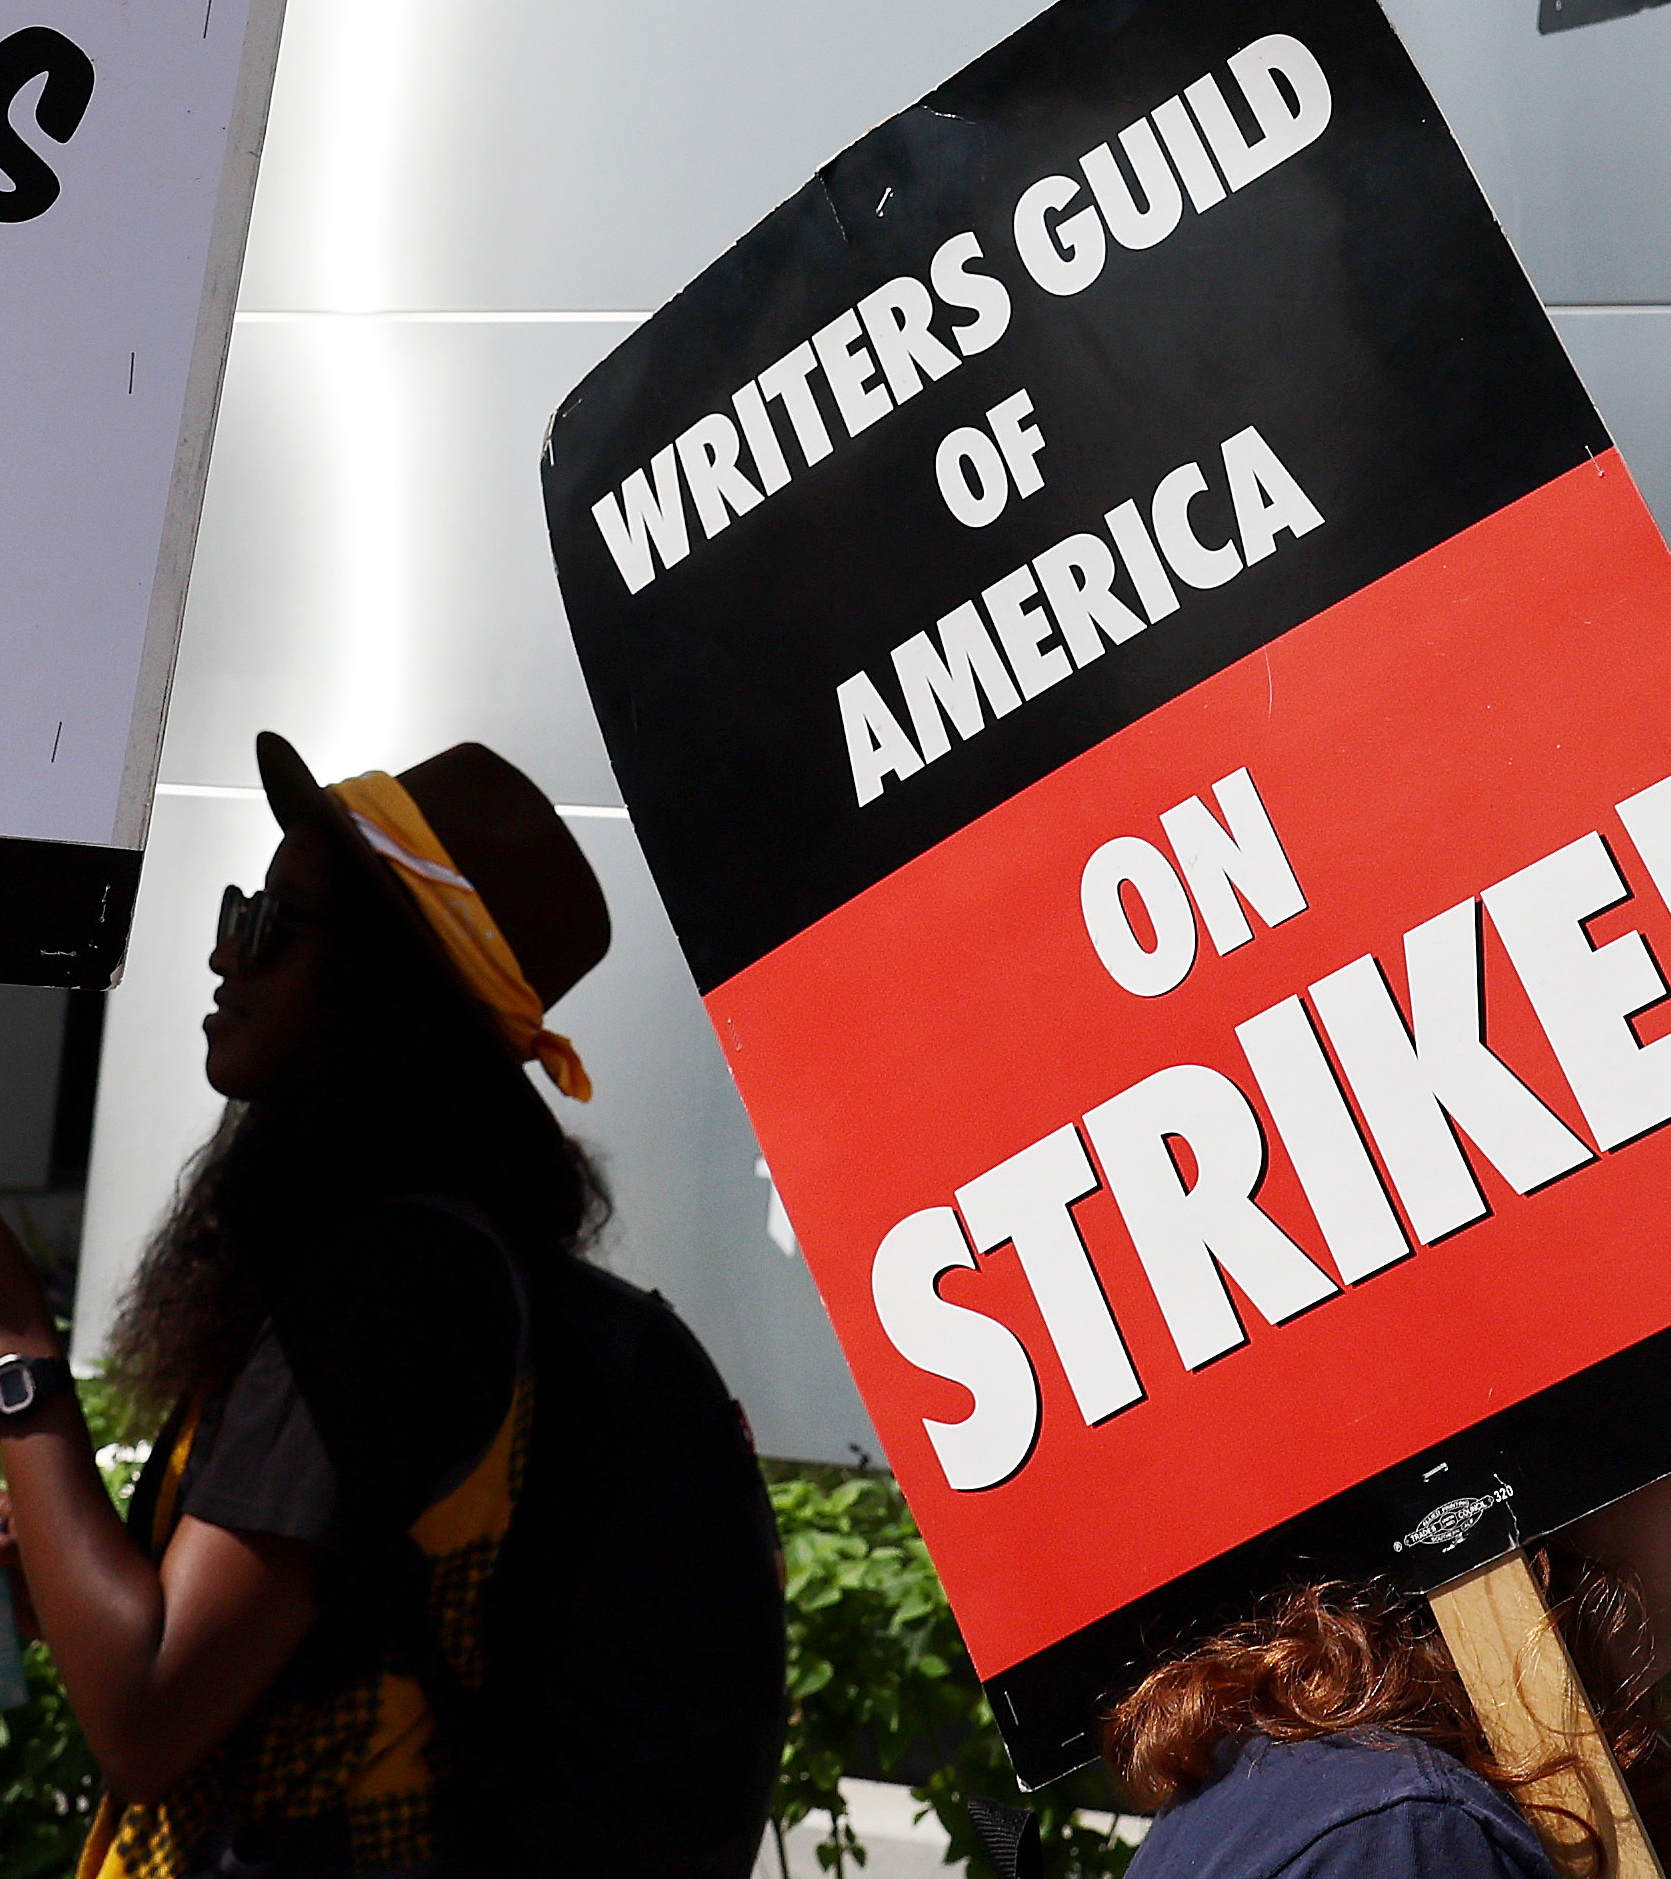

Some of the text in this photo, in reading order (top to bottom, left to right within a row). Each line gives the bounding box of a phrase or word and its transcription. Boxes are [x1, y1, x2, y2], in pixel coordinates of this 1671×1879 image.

[590, 33, 1333, 595] WRITERS GUILD
[935, 388, 1046, 528] OF
[836, 425, 1326, 808] AMERICA
[1078, 766, 1309, 998] ON
[1493, 1484, 1514, 1503] 320
